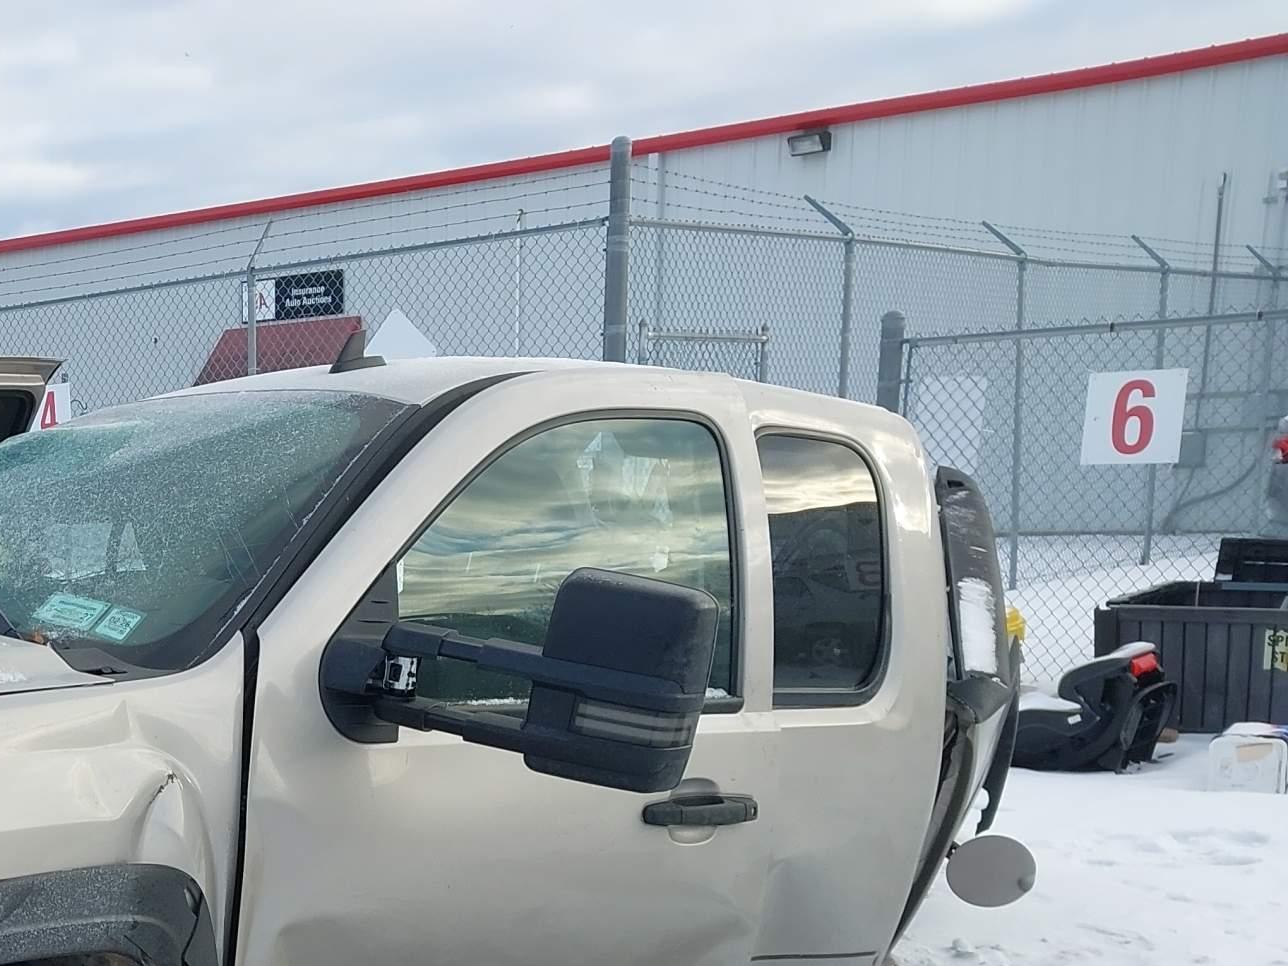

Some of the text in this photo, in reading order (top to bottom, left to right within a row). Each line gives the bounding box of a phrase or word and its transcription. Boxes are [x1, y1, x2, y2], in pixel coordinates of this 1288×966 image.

[285, 294, 332, 307] Auto Auctions
[291, 286, 326, 296] Insurance
[40, 390, 58, 431] 4
[1111, 379, 1156, 455] 6
